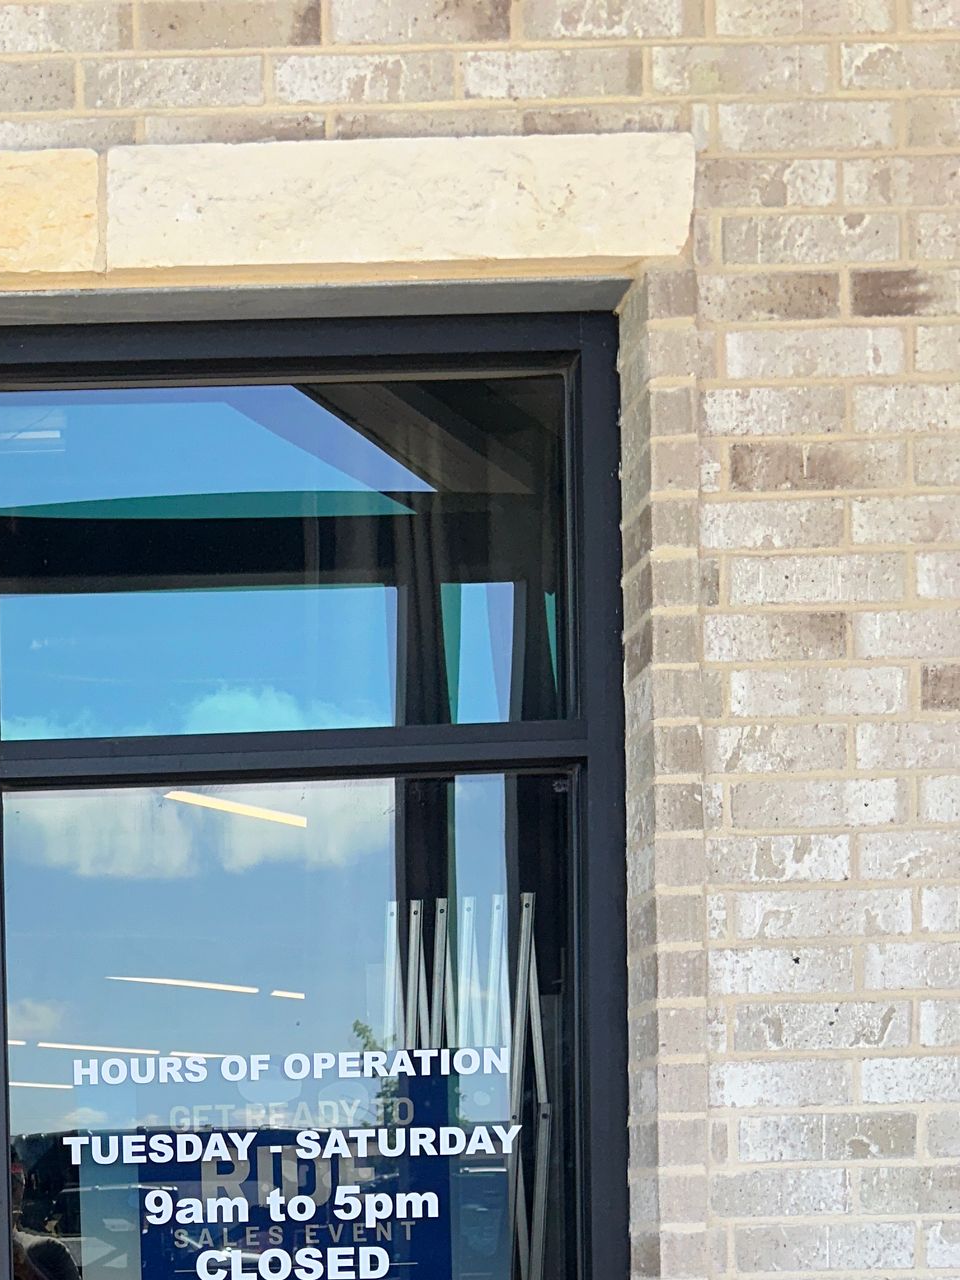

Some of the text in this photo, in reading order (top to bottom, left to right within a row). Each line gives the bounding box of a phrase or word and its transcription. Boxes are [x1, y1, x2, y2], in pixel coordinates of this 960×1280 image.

[73, 1047, 509, 1086] HOURS OF OPERATION
[170, 1096, 415, 1133] GET READY TO
[63, 1125, 522, 1165] TUESDAY - SATURDAY
[145, 1185, 439, 1229] 9am to 5pm
[174, 1221, 416, 1249] SALES EVENT
